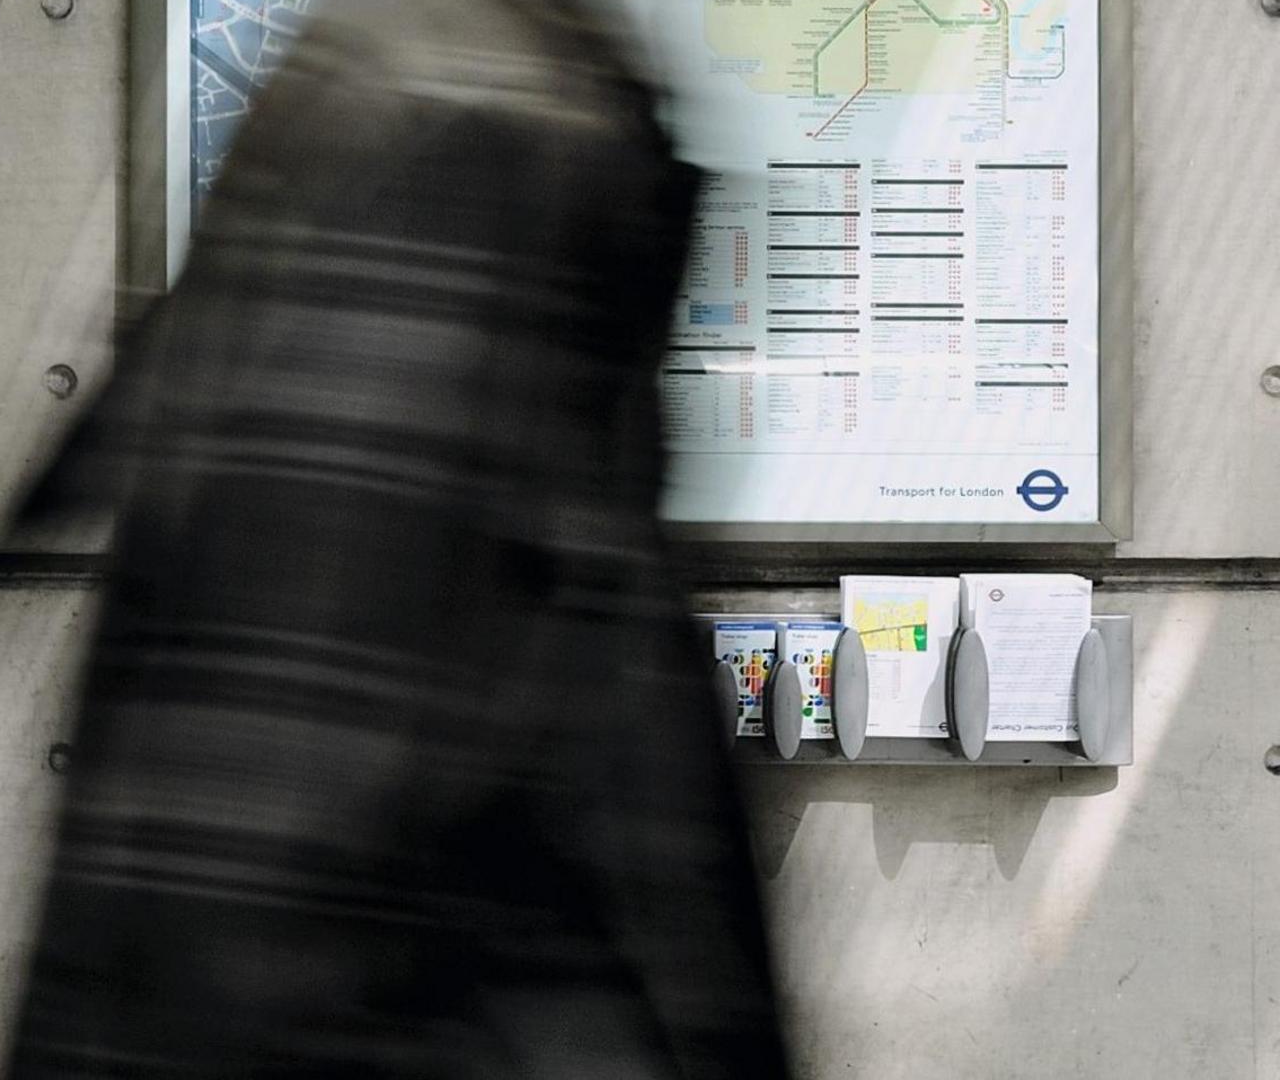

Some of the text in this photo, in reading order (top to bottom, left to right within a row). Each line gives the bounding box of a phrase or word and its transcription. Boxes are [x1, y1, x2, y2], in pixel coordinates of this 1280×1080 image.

[879, 486, 1004, 498] Transport for London
[992, 724, 1022, 732] Charter
[1024, 724, 1064, 732] Customer
